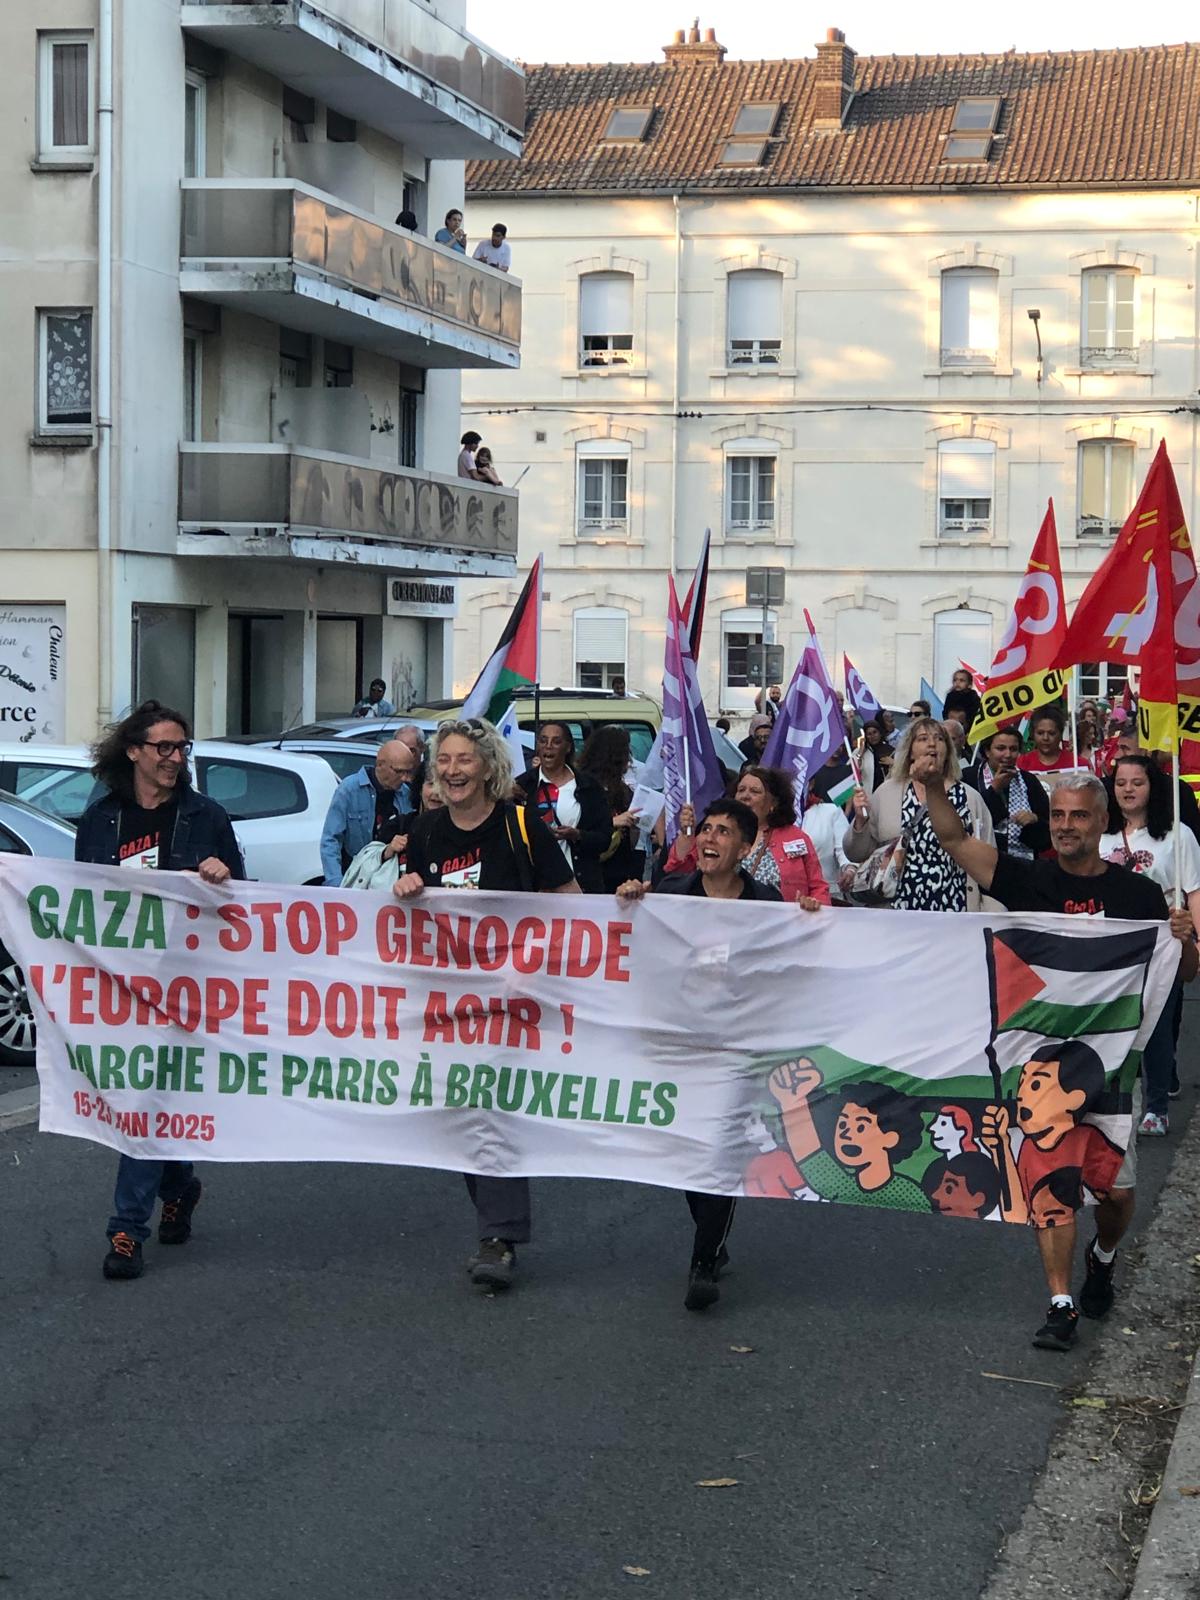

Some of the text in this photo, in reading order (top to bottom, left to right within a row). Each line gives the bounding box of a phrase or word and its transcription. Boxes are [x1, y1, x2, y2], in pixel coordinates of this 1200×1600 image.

[120, 834, 151, 859] GAZA
[26, 885, 168, 950] GAZA
[217, 901, 358, 956] STOP
[375, 905, 633, 983] GENOCIDE
[287, 980, 407, 1040] DOIT
[422, 991, 542, 1051] AGIR
[65, 1043, 679, 1126] ARCHE DE PARIS À BRUXELLES
[155, 1111, 216, 1142] 2025
